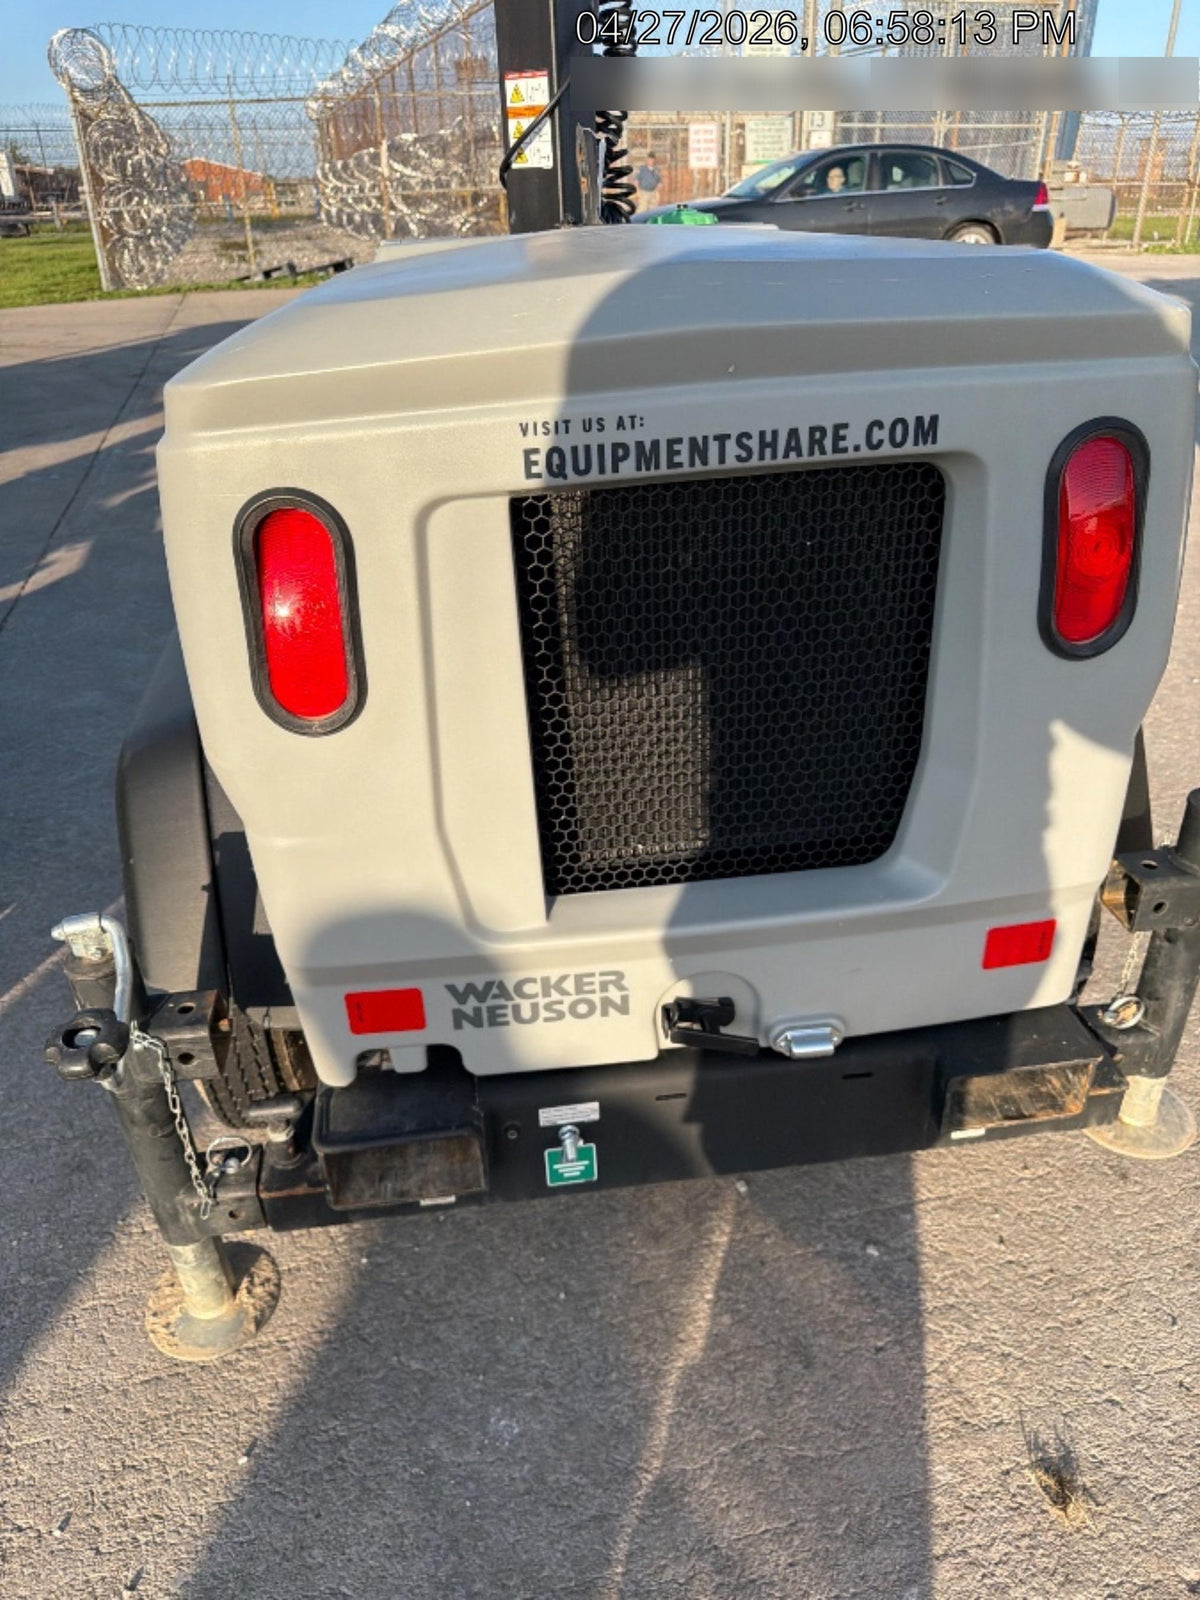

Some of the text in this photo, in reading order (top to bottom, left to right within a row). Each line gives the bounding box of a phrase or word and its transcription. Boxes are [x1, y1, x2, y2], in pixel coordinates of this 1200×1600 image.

[519, 415, 645, 437] VISIT US AT:
[523, 414, 940, 480] EQUIPMENTSHARE.COM
[444, 970, 629, 1004] WACKER
[451, 993, 630, 1030] NEUSON
